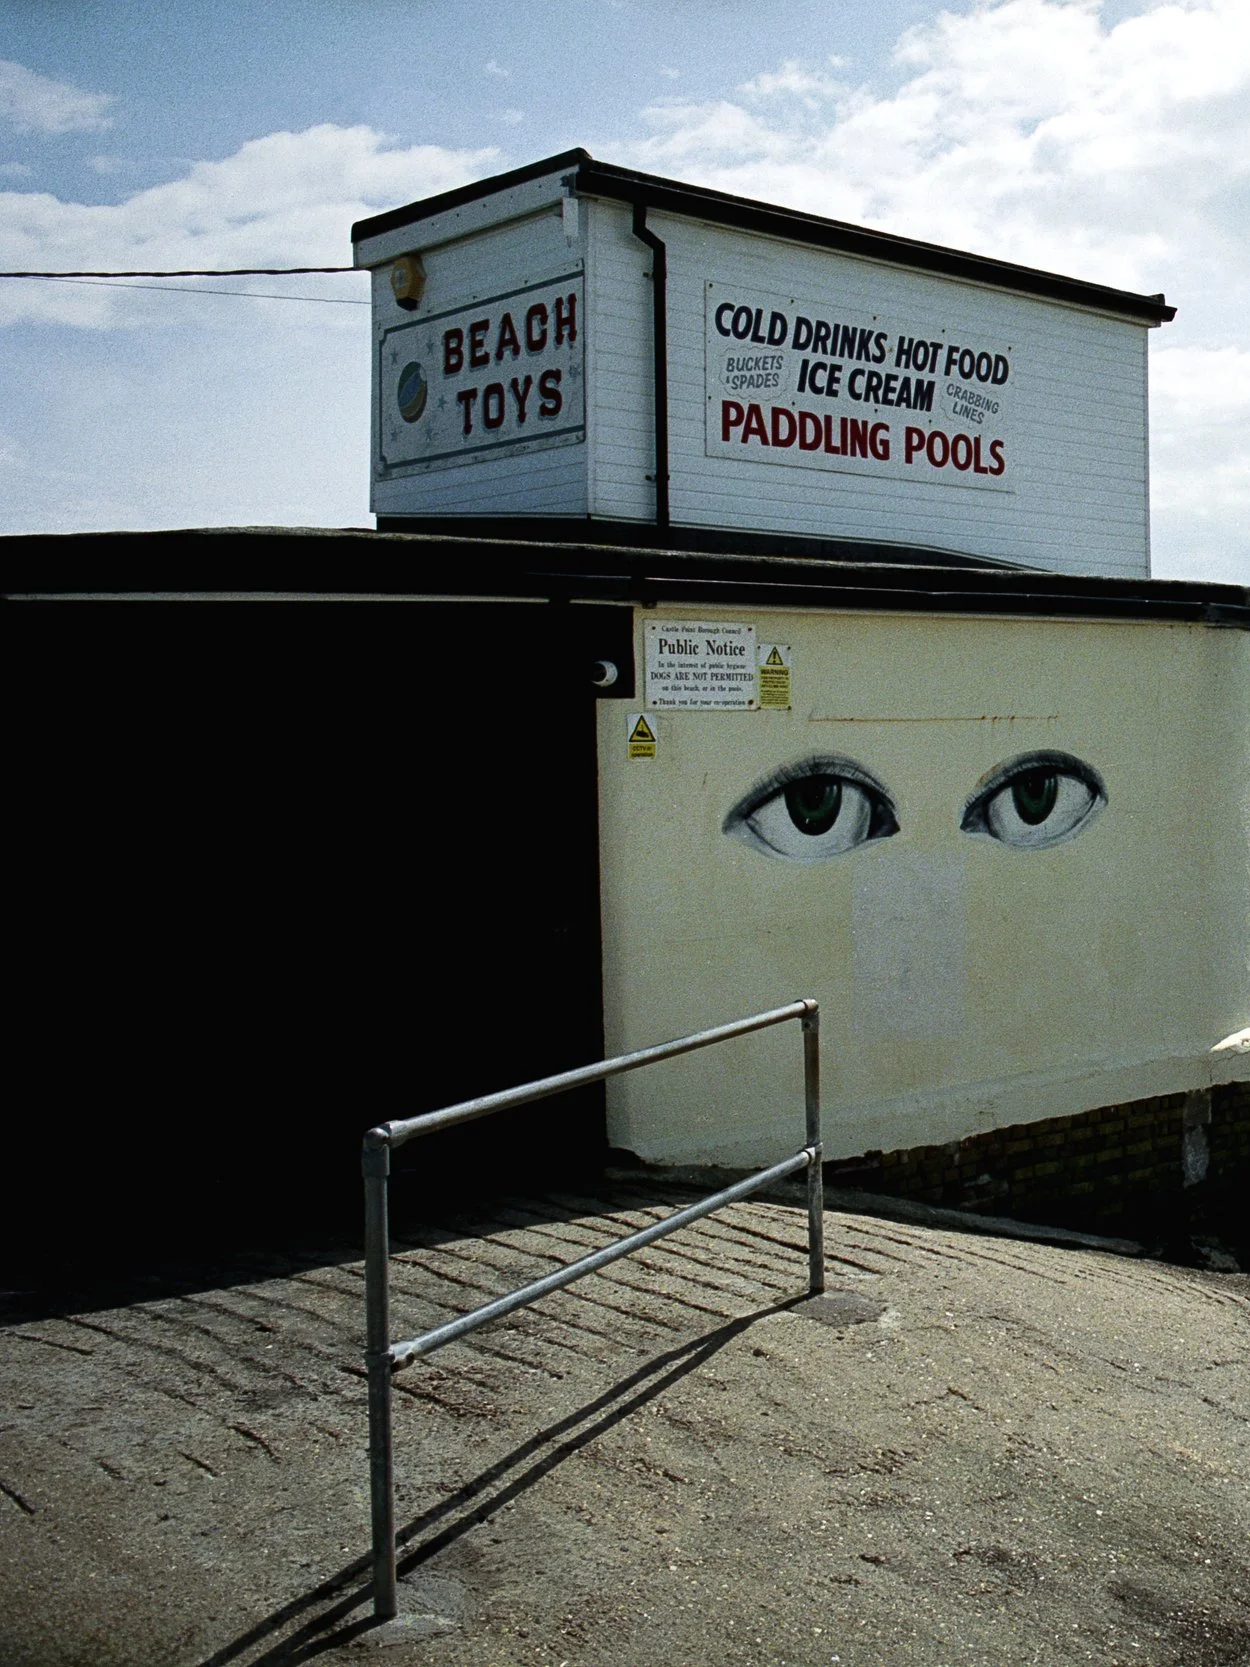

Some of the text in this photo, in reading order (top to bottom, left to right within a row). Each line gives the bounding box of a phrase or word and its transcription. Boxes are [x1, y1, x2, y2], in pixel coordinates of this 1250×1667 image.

[443, 292, 577, 375] BEACH
[715, 302, 1010, 386] COLD DRINKS HOT FOOD
[726, 355, 784, 372] BUCKETS
[731, 373, 780, 390] SPADES
[797, 358, 936, 412] ICE CREAM
[456, 367, 563, 436] TOYS
[945, 382, 1001, 415] CRABBING
[952, 401, 986, 425] LINES
[721, 399, 890, 461] PADDLING
[904, 425, 1006, 476] POOLS
[661, 625, 679, 633] Castle
[698, 626, 720, 635] Borough
[721, 627, 742, 635] Council
[658, 638, 746, 656] Public Notice
[650, 671, 671, 680] DOGS
[674, 672, 690, 681] ARE
[692, 672, 708, 681] NOT
[710, 672, 754, 681] PERMITTED
